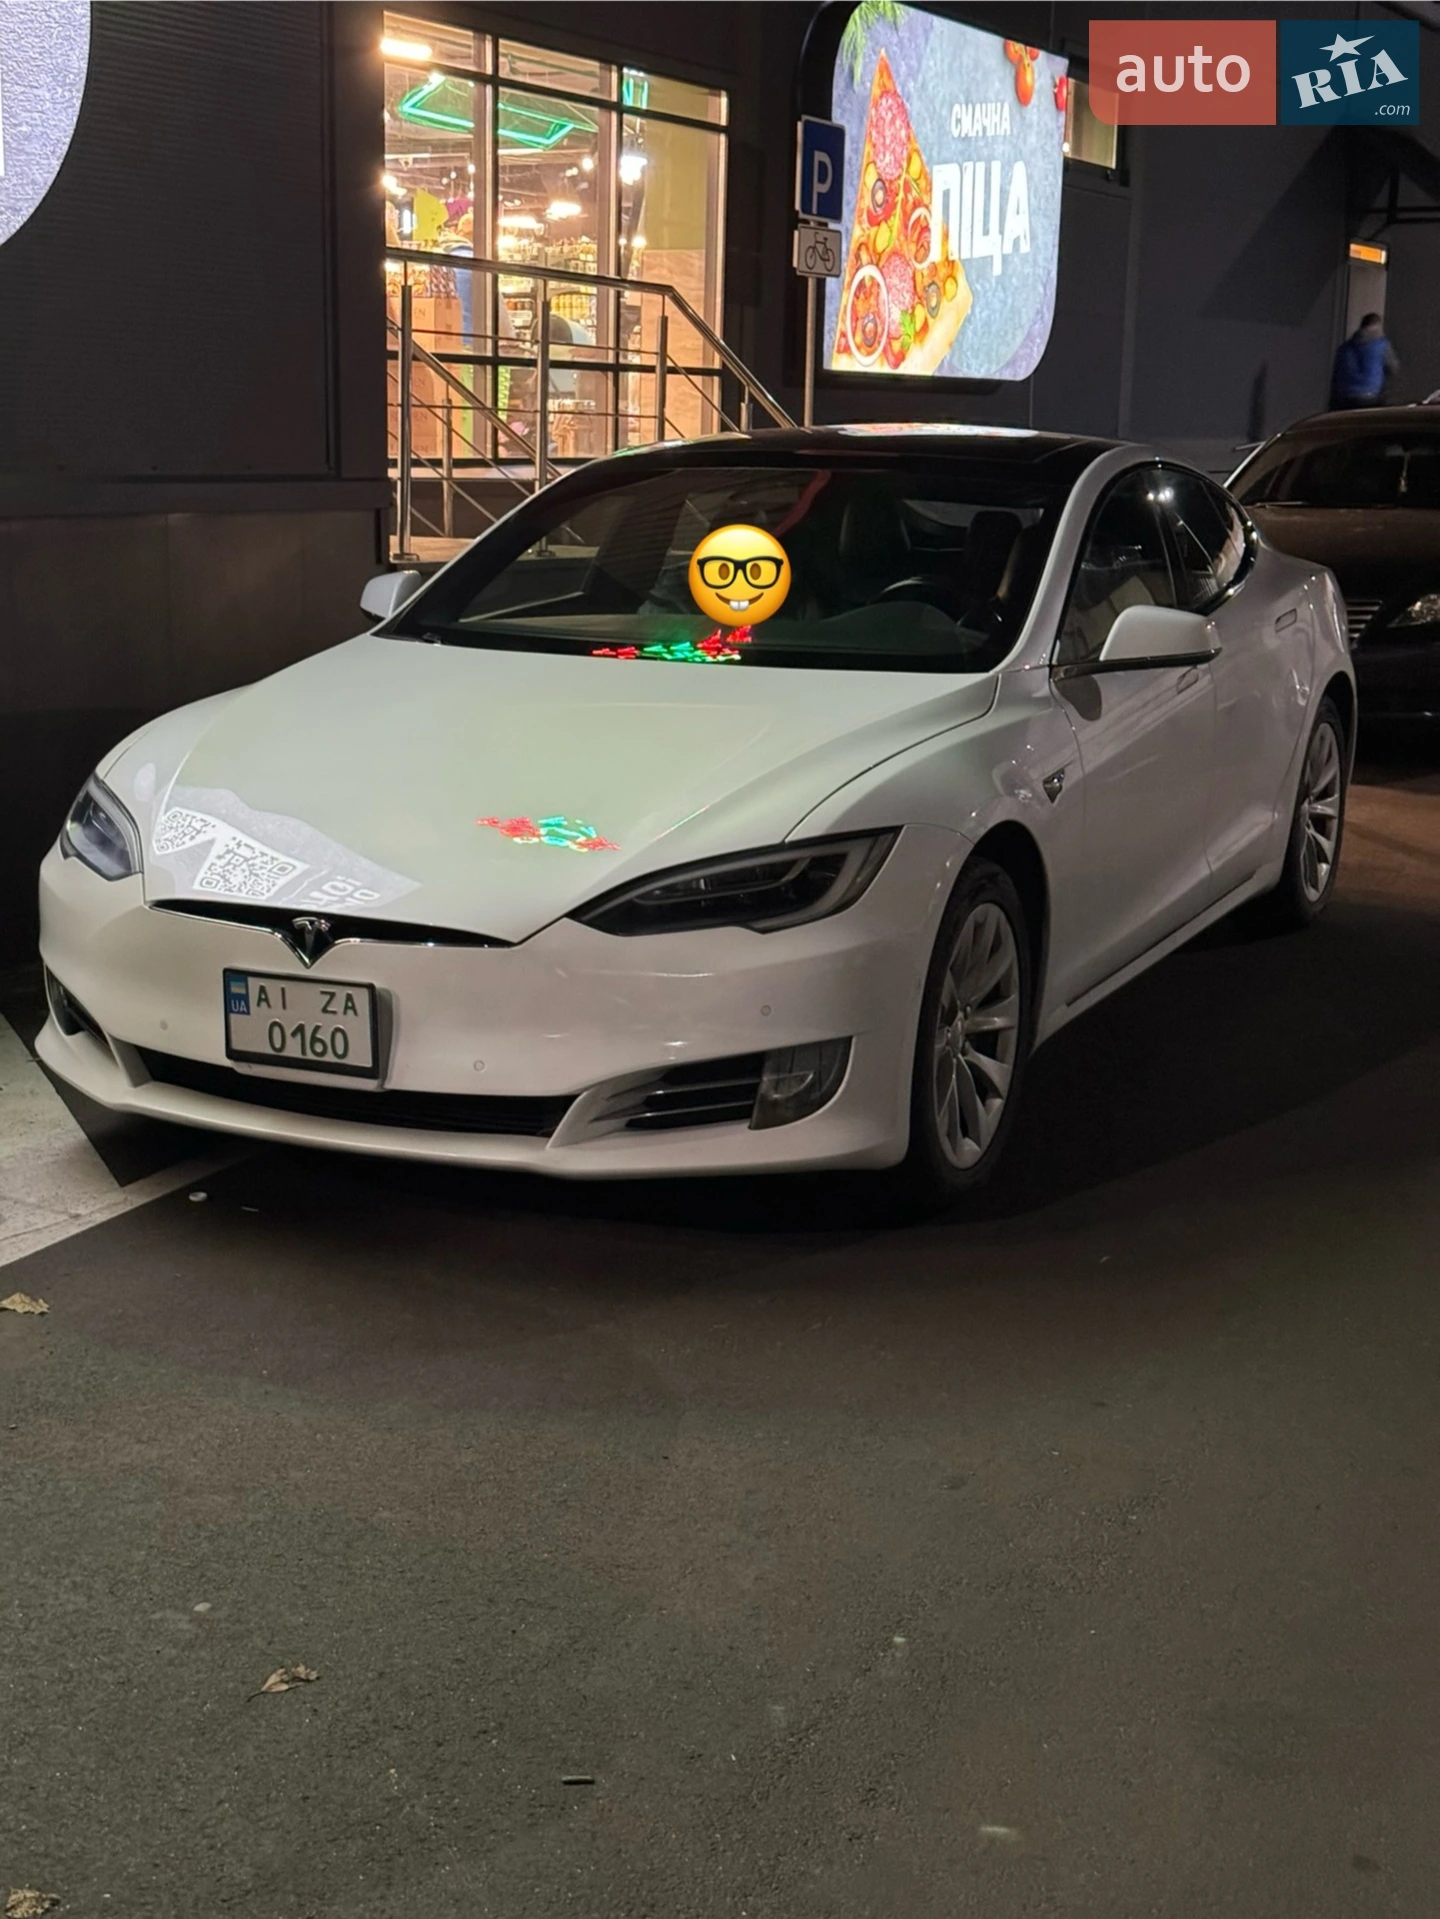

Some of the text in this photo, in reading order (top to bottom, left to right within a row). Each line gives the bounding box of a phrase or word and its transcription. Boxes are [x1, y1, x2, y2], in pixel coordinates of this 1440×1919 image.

[951, 102, 1011, 138] СМАЧНА
[812, 150, 833, 215] P
[929, 160, 1031, 276] ПІЦА
[231, 999, 248, 1012] UA
[256, 984, 358, 1016] AI ZA
[268, 1020, 349, 1060] 0160
